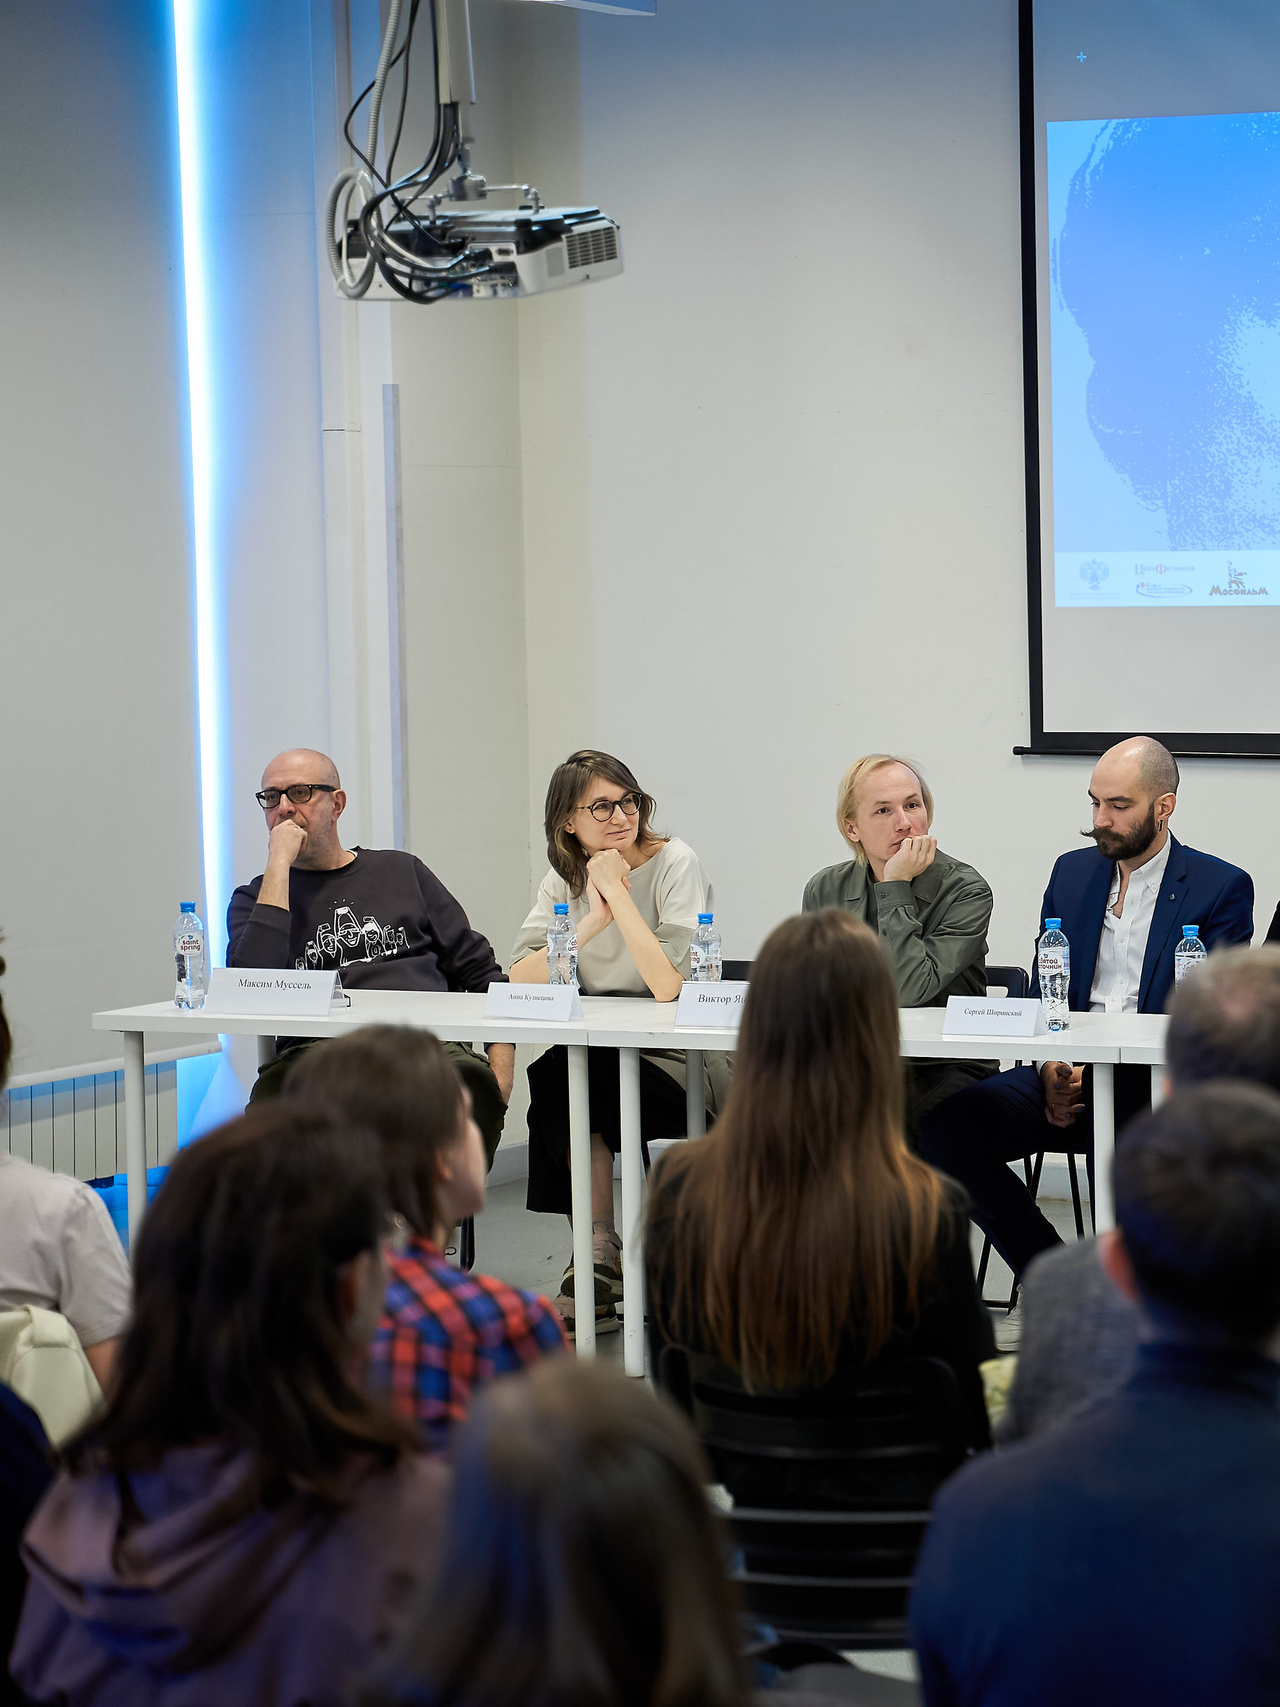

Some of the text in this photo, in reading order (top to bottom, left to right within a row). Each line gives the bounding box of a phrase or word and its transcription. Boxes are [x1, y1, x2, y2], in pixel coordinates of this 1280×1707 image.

[238, 978, 312, 991] Максим Муссель
[698, 994, 732, 1006] Виктор
[964, 1008, 985, 1016] Сергей
